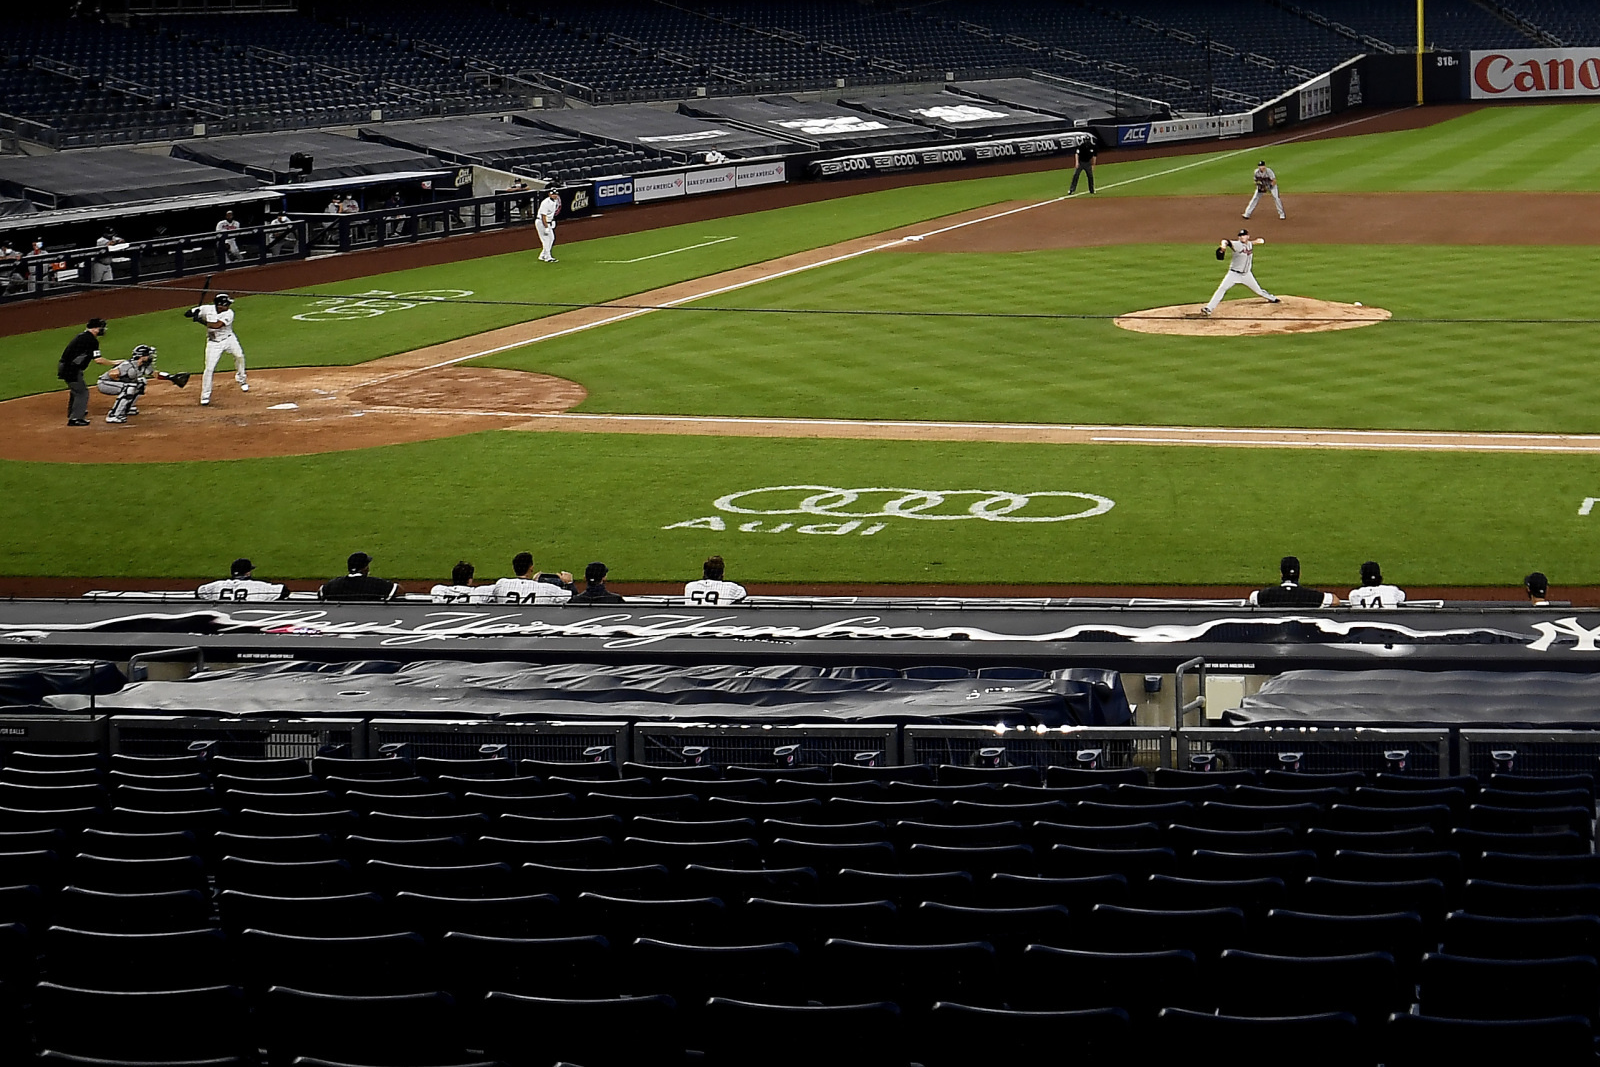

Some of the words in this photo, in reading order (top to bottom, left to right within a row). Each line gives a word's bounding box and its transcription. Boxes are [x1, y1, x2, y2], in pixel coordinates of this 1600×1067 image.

[1123, 127, 1146, 141] ACC
[994, 144, 1016, 157] COOL
[1035, 139, 1058, 152] COOL
[894, 154, 920, 168] COOL
[941, 149, 966, 163] COOL
[843, 158, 871, 172] COOL
[459, 168, 470, 178] OXI
[455, 175, 473, 187] CLEAN
[575, 191, 587, 201] OXI
[599, 183, 632, 198] GEICO
[571, 198, 589, 211] CLEAN
[661, 515, 888, 536] Audi
